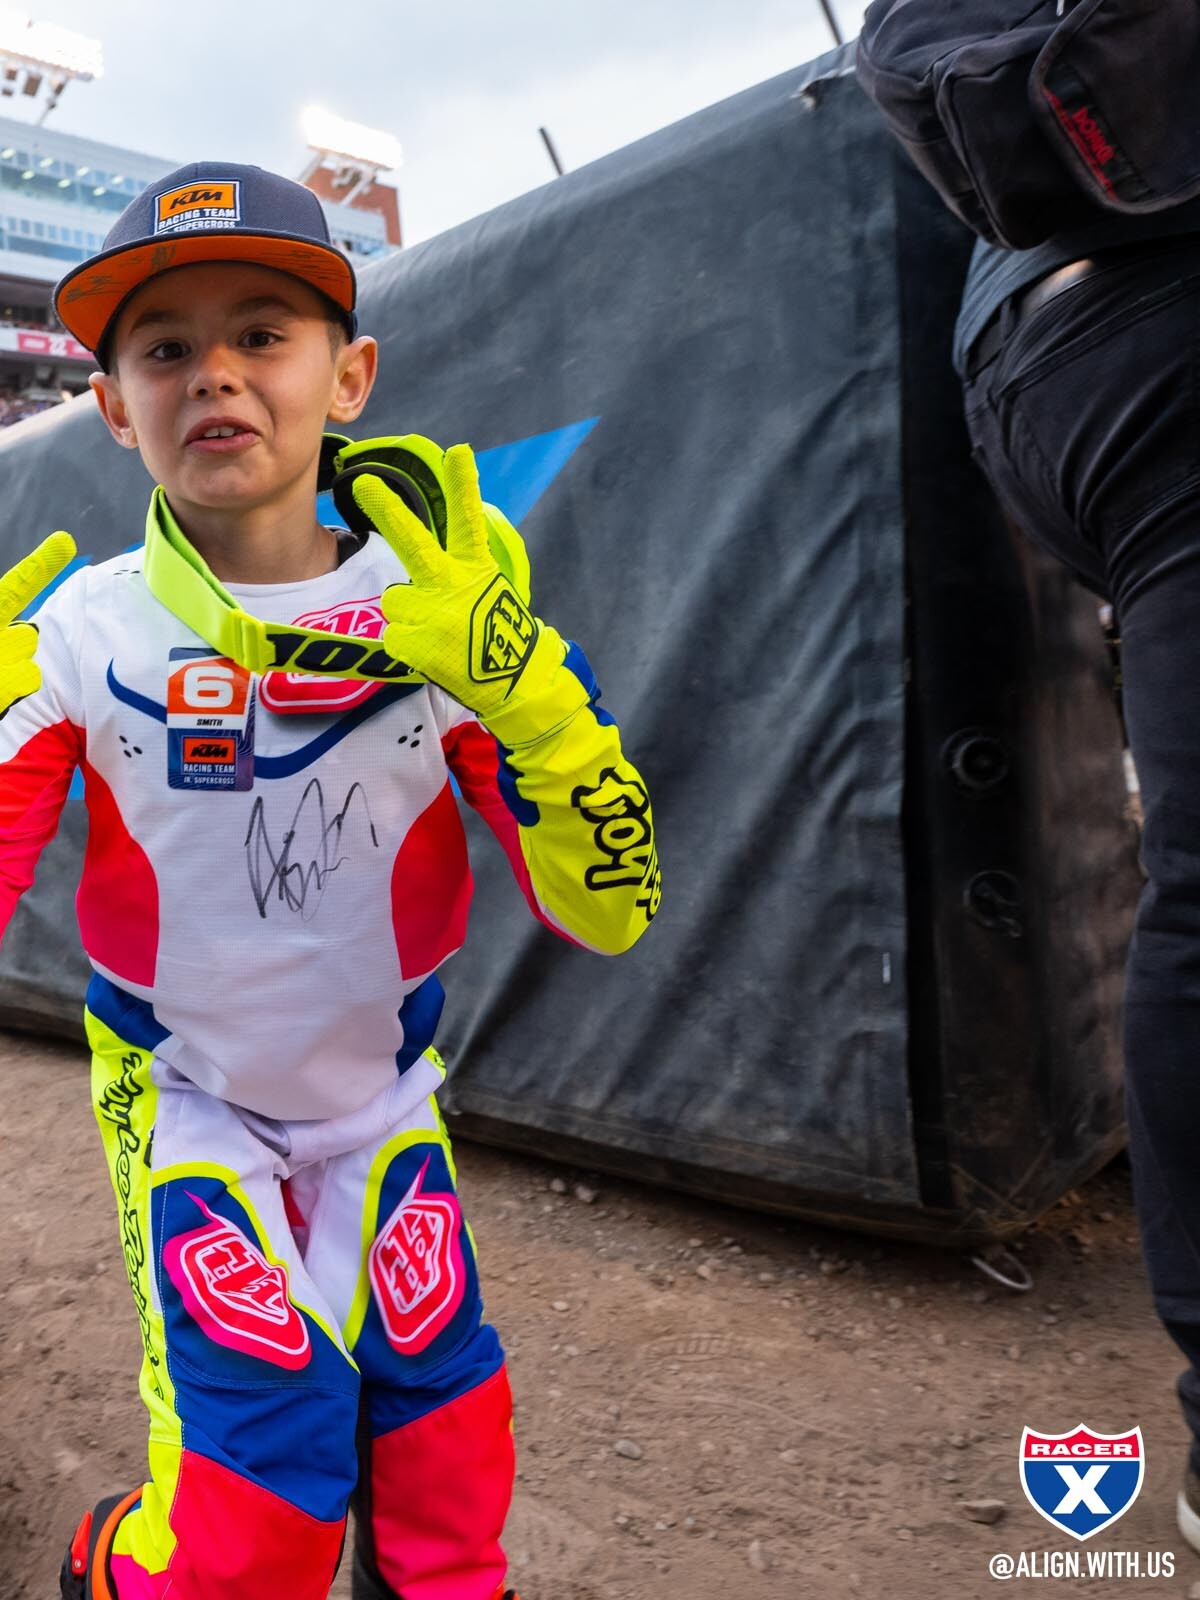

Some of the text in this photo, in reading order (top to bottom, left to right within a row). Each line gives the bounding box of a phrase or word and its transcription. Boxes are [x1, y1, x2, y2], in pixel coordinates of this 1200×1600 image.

[169, 188, 224, 210] KTM
[158, 208, 235, 231] RACING TEAM
[266, 633, 413, 678] 100
[183, 665, 234, 709] 6
[196, 718, 224, 727] SMITH
[191, 743, 229, 758] KTM
[183, 764, 235, 773] RACING TEAM
[194, 776, 235, 785] SUPERCROSS
